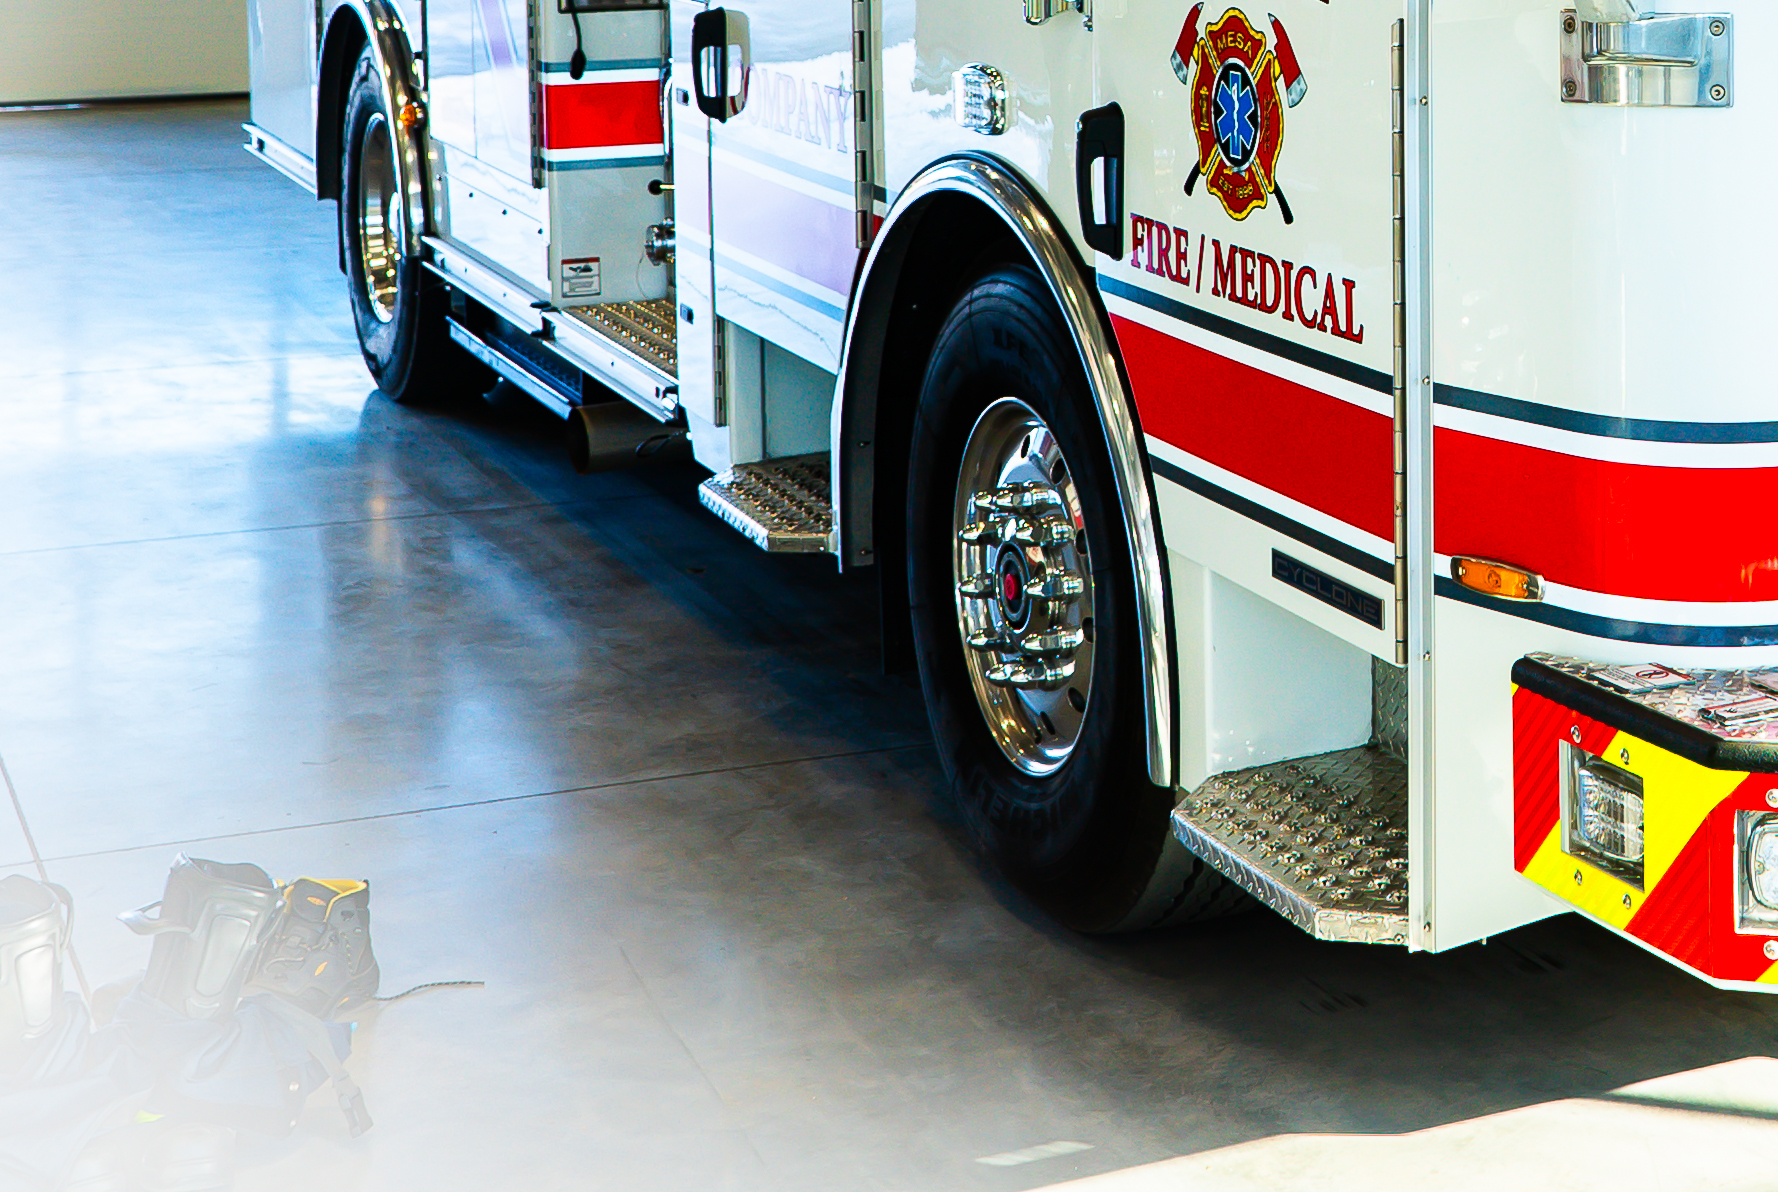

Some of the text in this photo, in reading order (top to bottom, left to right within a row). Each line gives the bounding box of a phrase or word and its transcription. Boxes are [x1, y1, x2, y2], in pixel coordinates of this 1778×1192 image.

[1216, 31, 1253, 59] MESA
[1130, 213, 1191, 286] FIRE
[1211, 238, 1363, 344] MEDICAL
[1273, 556, 1379, 622] CYCLONE
